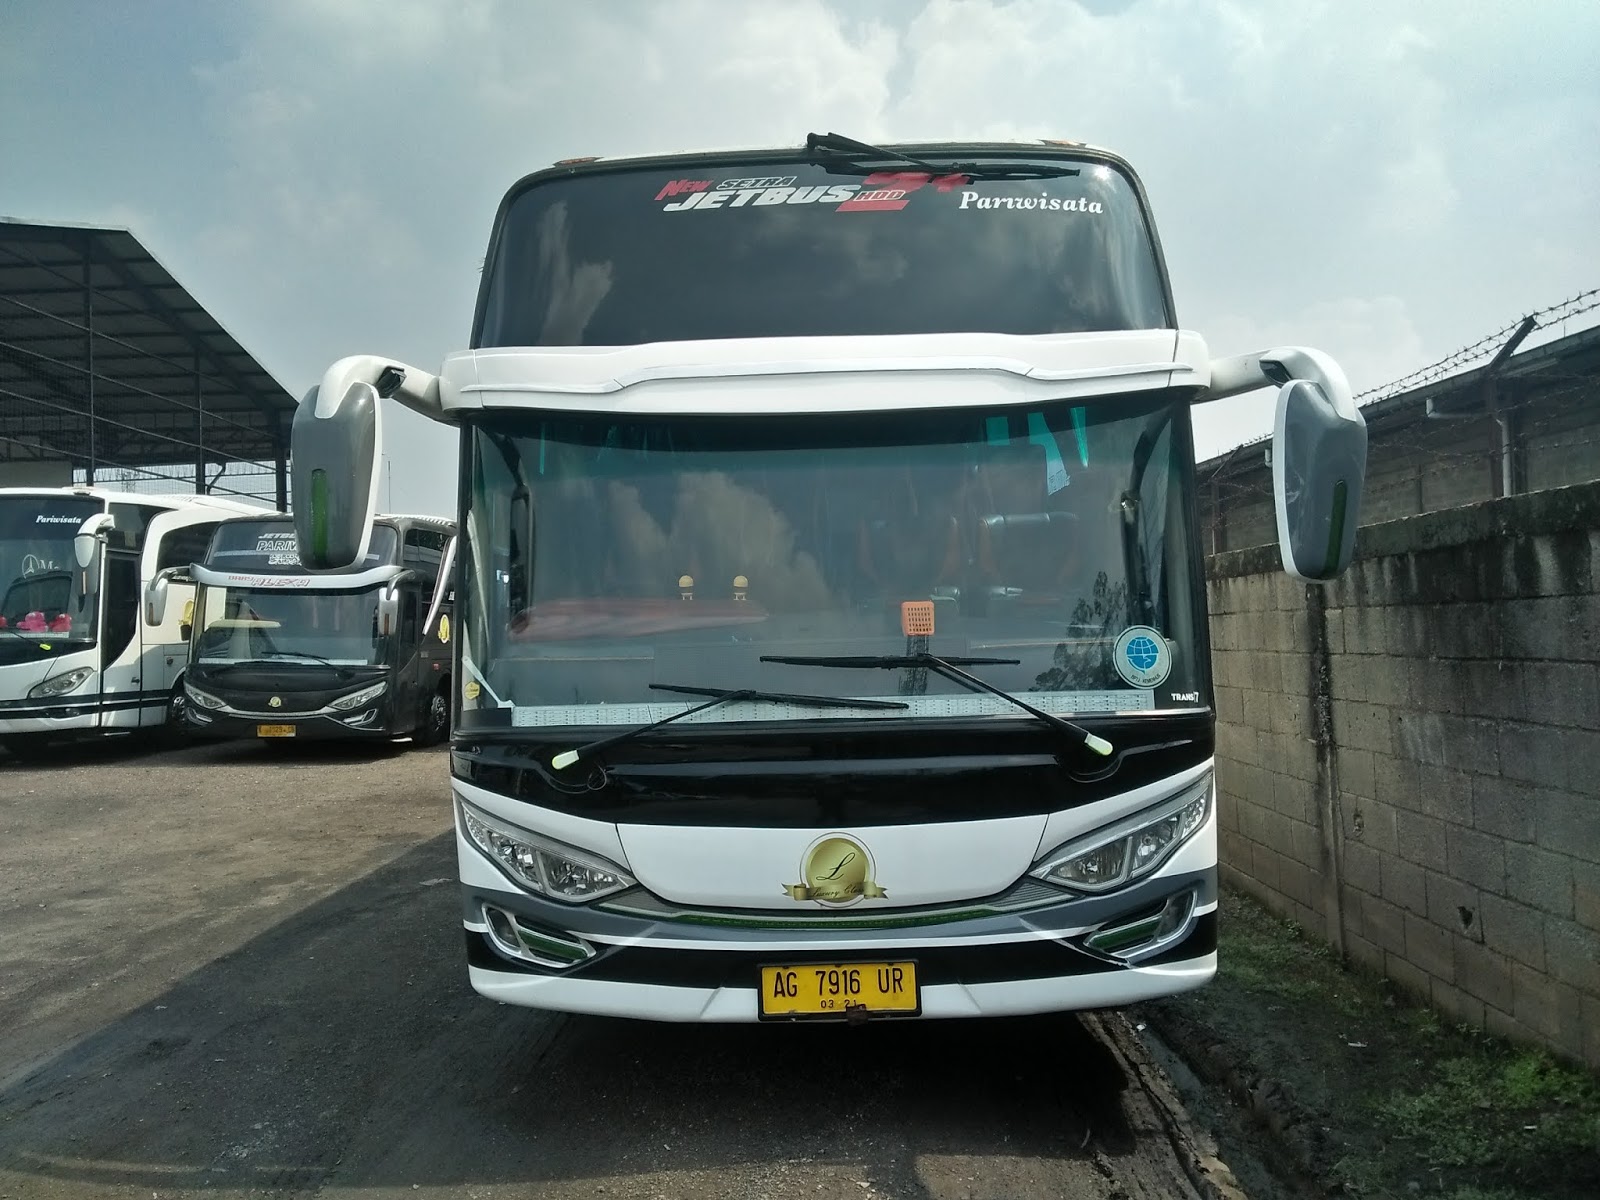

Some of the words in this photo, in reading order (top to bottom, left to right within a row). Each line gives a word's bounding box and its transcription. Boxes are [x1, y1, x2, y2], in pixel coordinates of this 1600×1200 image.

[716, 176, 797, 191] SETRA
[663, 184, 862, 212] JETBUS
[959, 191, 1104, 214] Pariwisata
[36, 515, 82, 524] Pariwisata
[812, 887, 840, 897] Luxury
[773, 971, 798, 998] AG
[815, 969, 861, 996] 7916
[877, 967, 903, 994] UR
[820, 999, 834, 1009] 03
